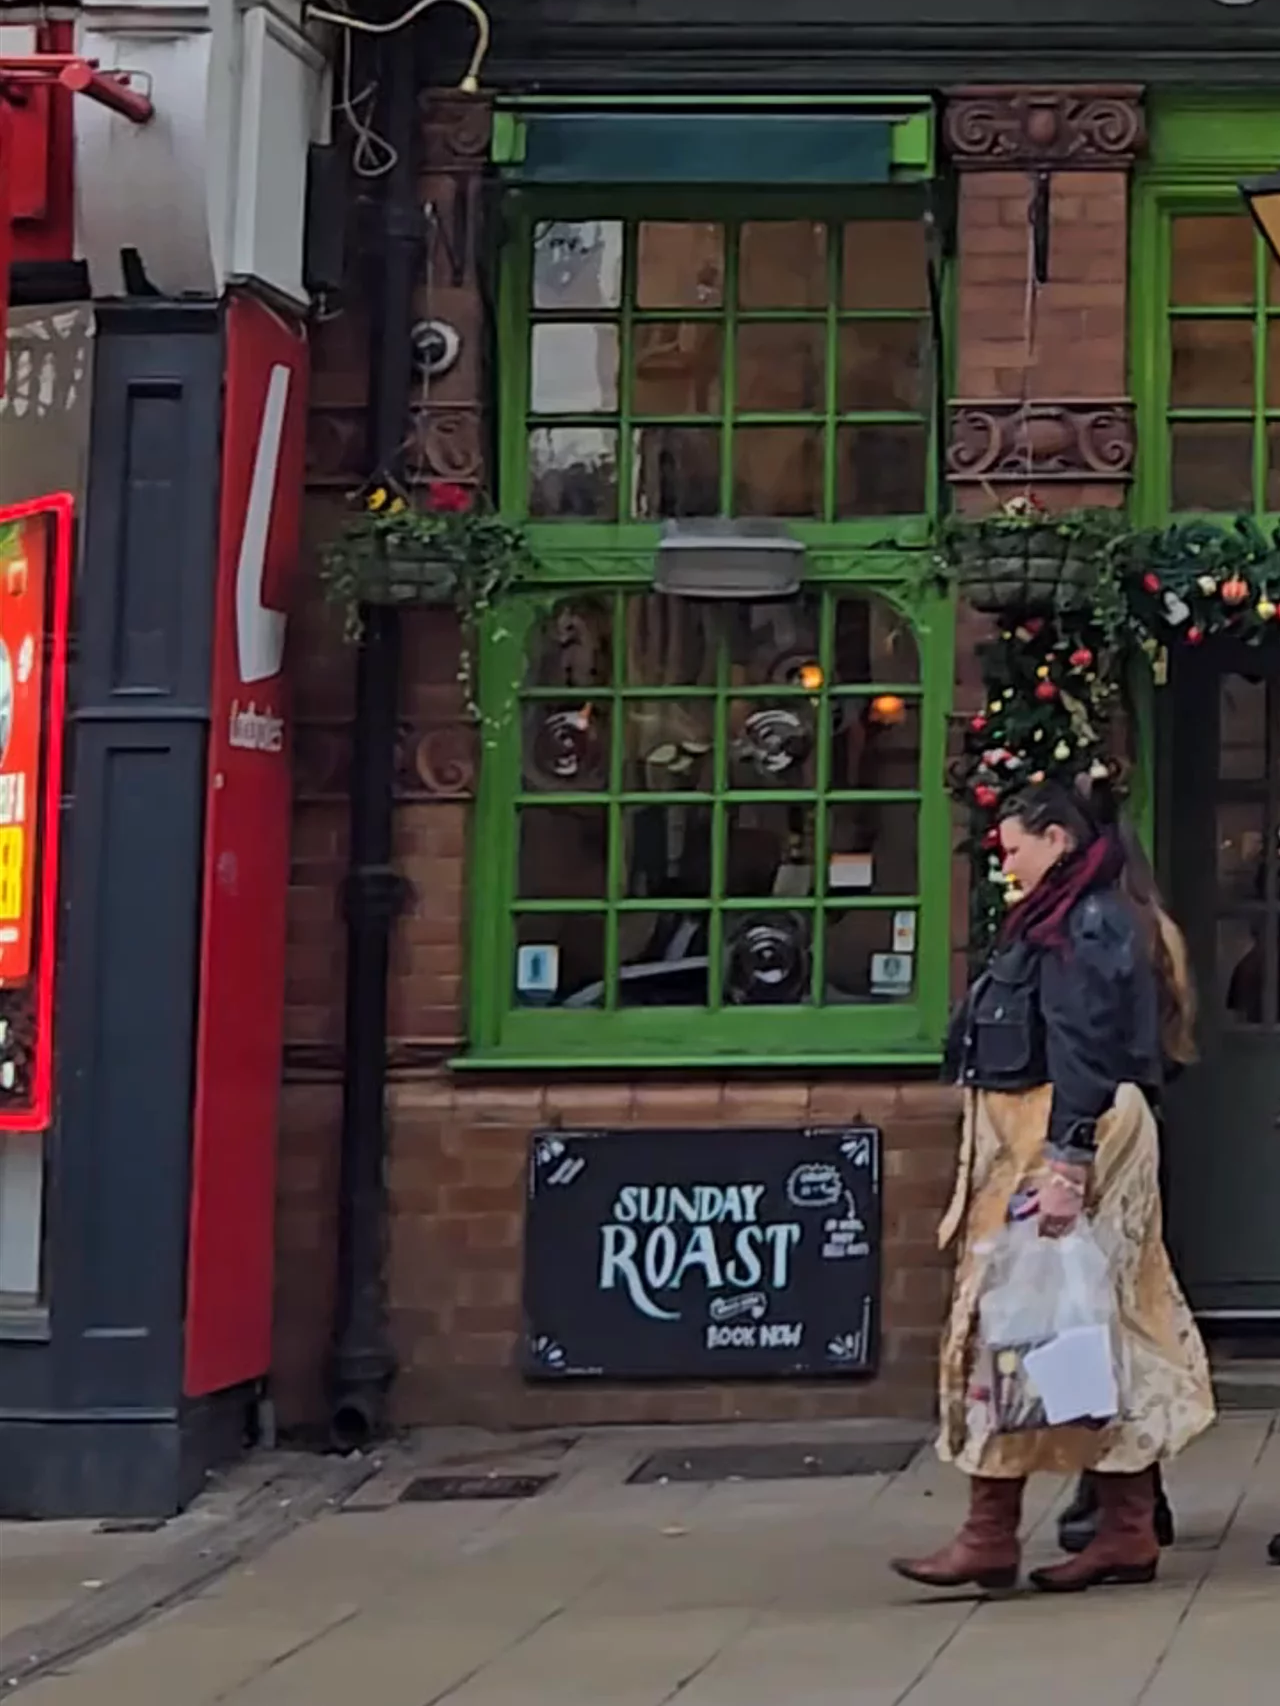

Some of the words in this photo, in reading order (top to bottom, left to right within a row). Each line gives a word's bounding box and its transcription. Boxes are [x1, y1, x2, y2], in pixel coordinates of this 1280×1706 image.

[613, 1186, 765, 1223] SUNDAY
[599, 1222, 801, 1321] ROAST
[706, 1324, 757, 1350] BOOK
[759, 1322, 803, 1348] NOW
